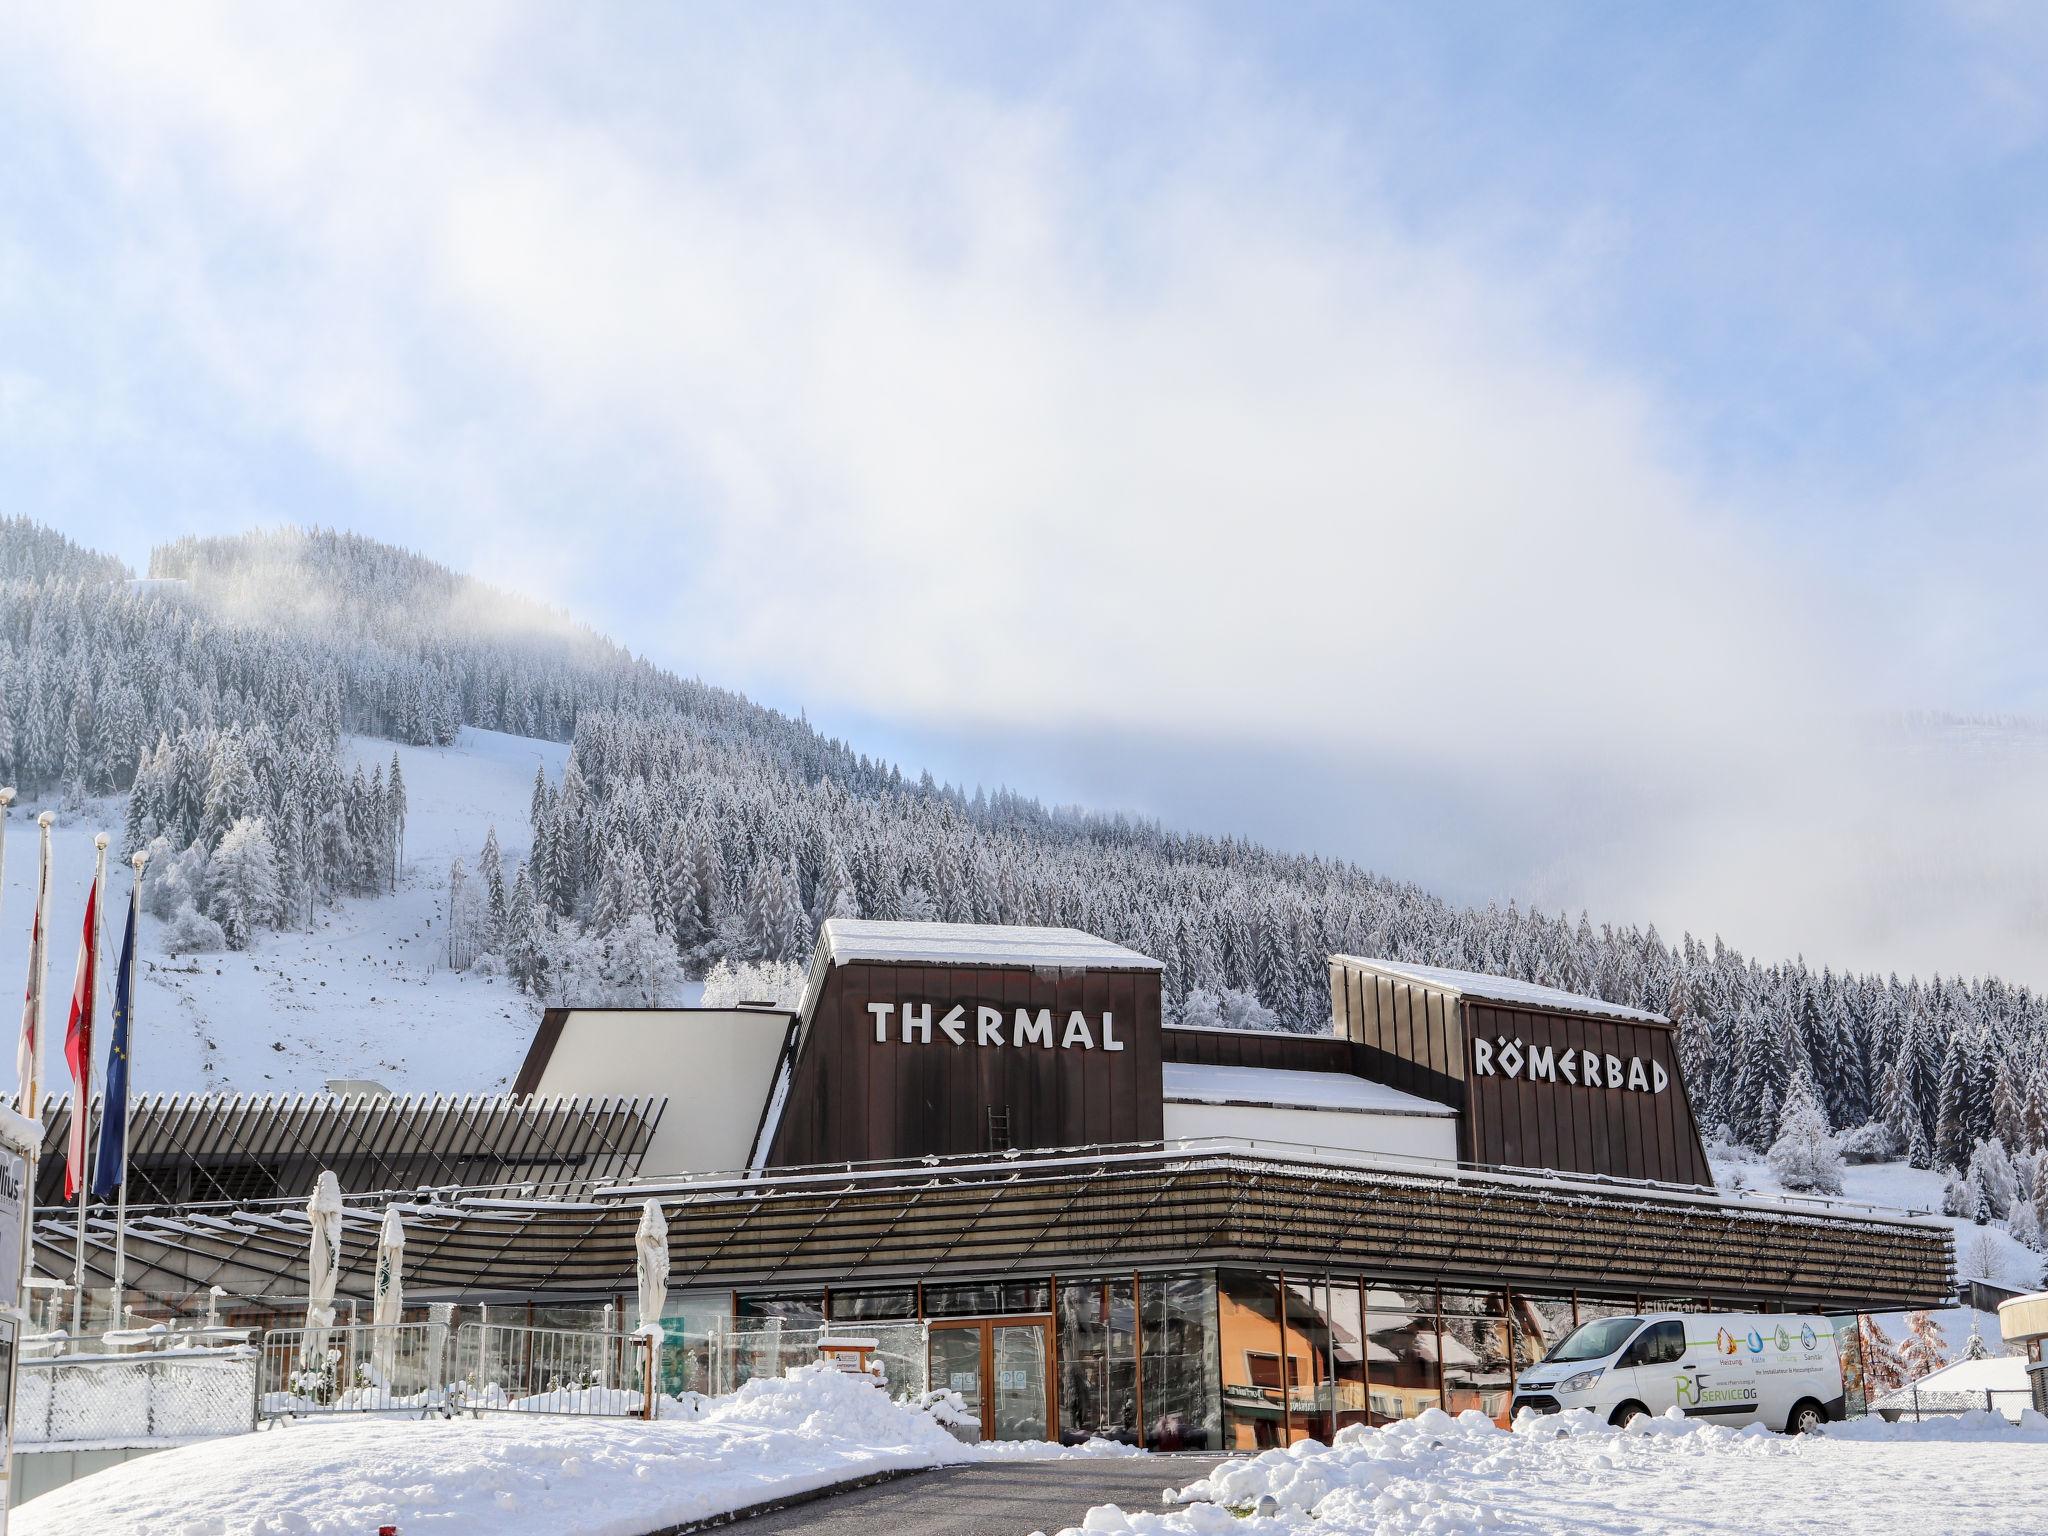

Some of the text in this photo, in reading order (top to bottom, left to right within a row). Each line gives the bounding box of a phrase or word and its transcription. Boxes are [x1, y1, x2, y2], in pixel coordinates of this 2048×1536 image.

[867, 1002, 1124, 1050] THERMAL
[1475, 1035, 1669, 1094] RÖMERBAD
[1804, 1353, 1823, 1361] Sanitär
